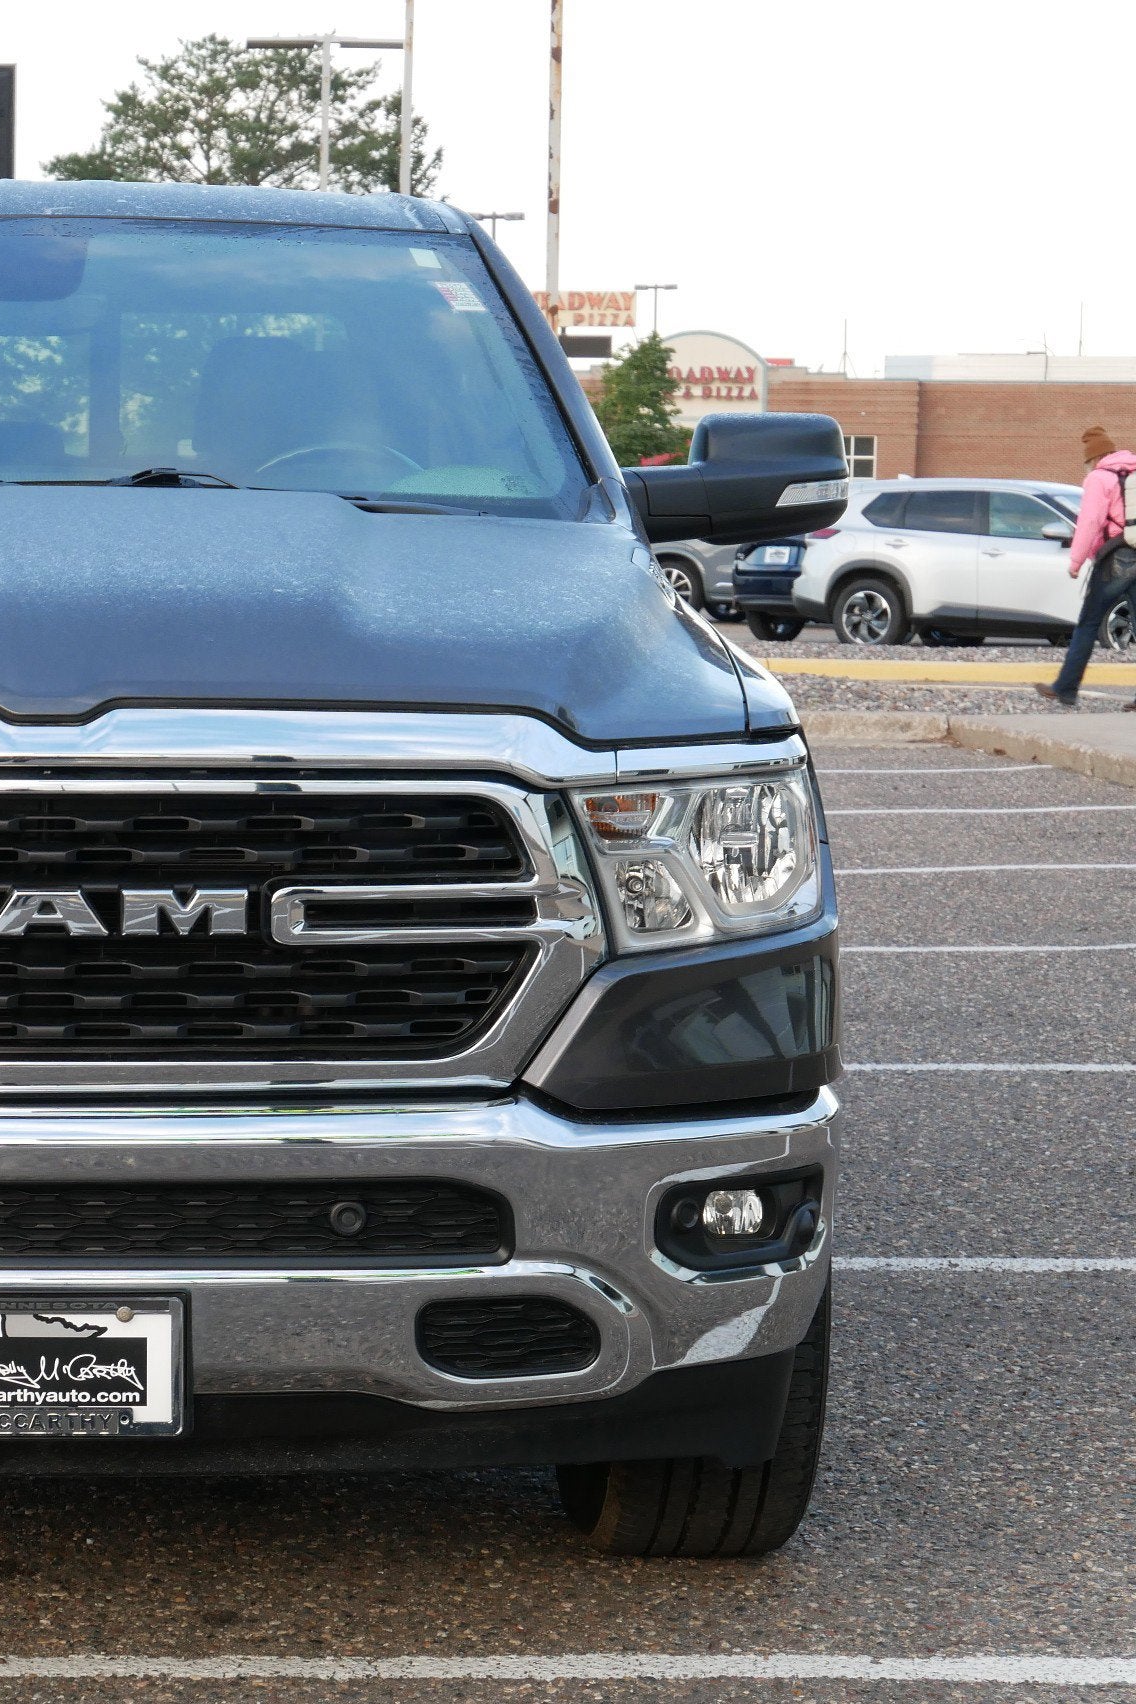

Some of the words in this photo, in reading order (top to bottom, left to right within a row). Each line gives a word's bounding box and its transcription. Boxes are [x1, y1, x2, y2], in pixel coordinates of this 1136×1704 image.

[572, 313, 635, 327] PIZZA
[683, 385, 694, 400] &
[702, 386, 759, 400] PIZZA
